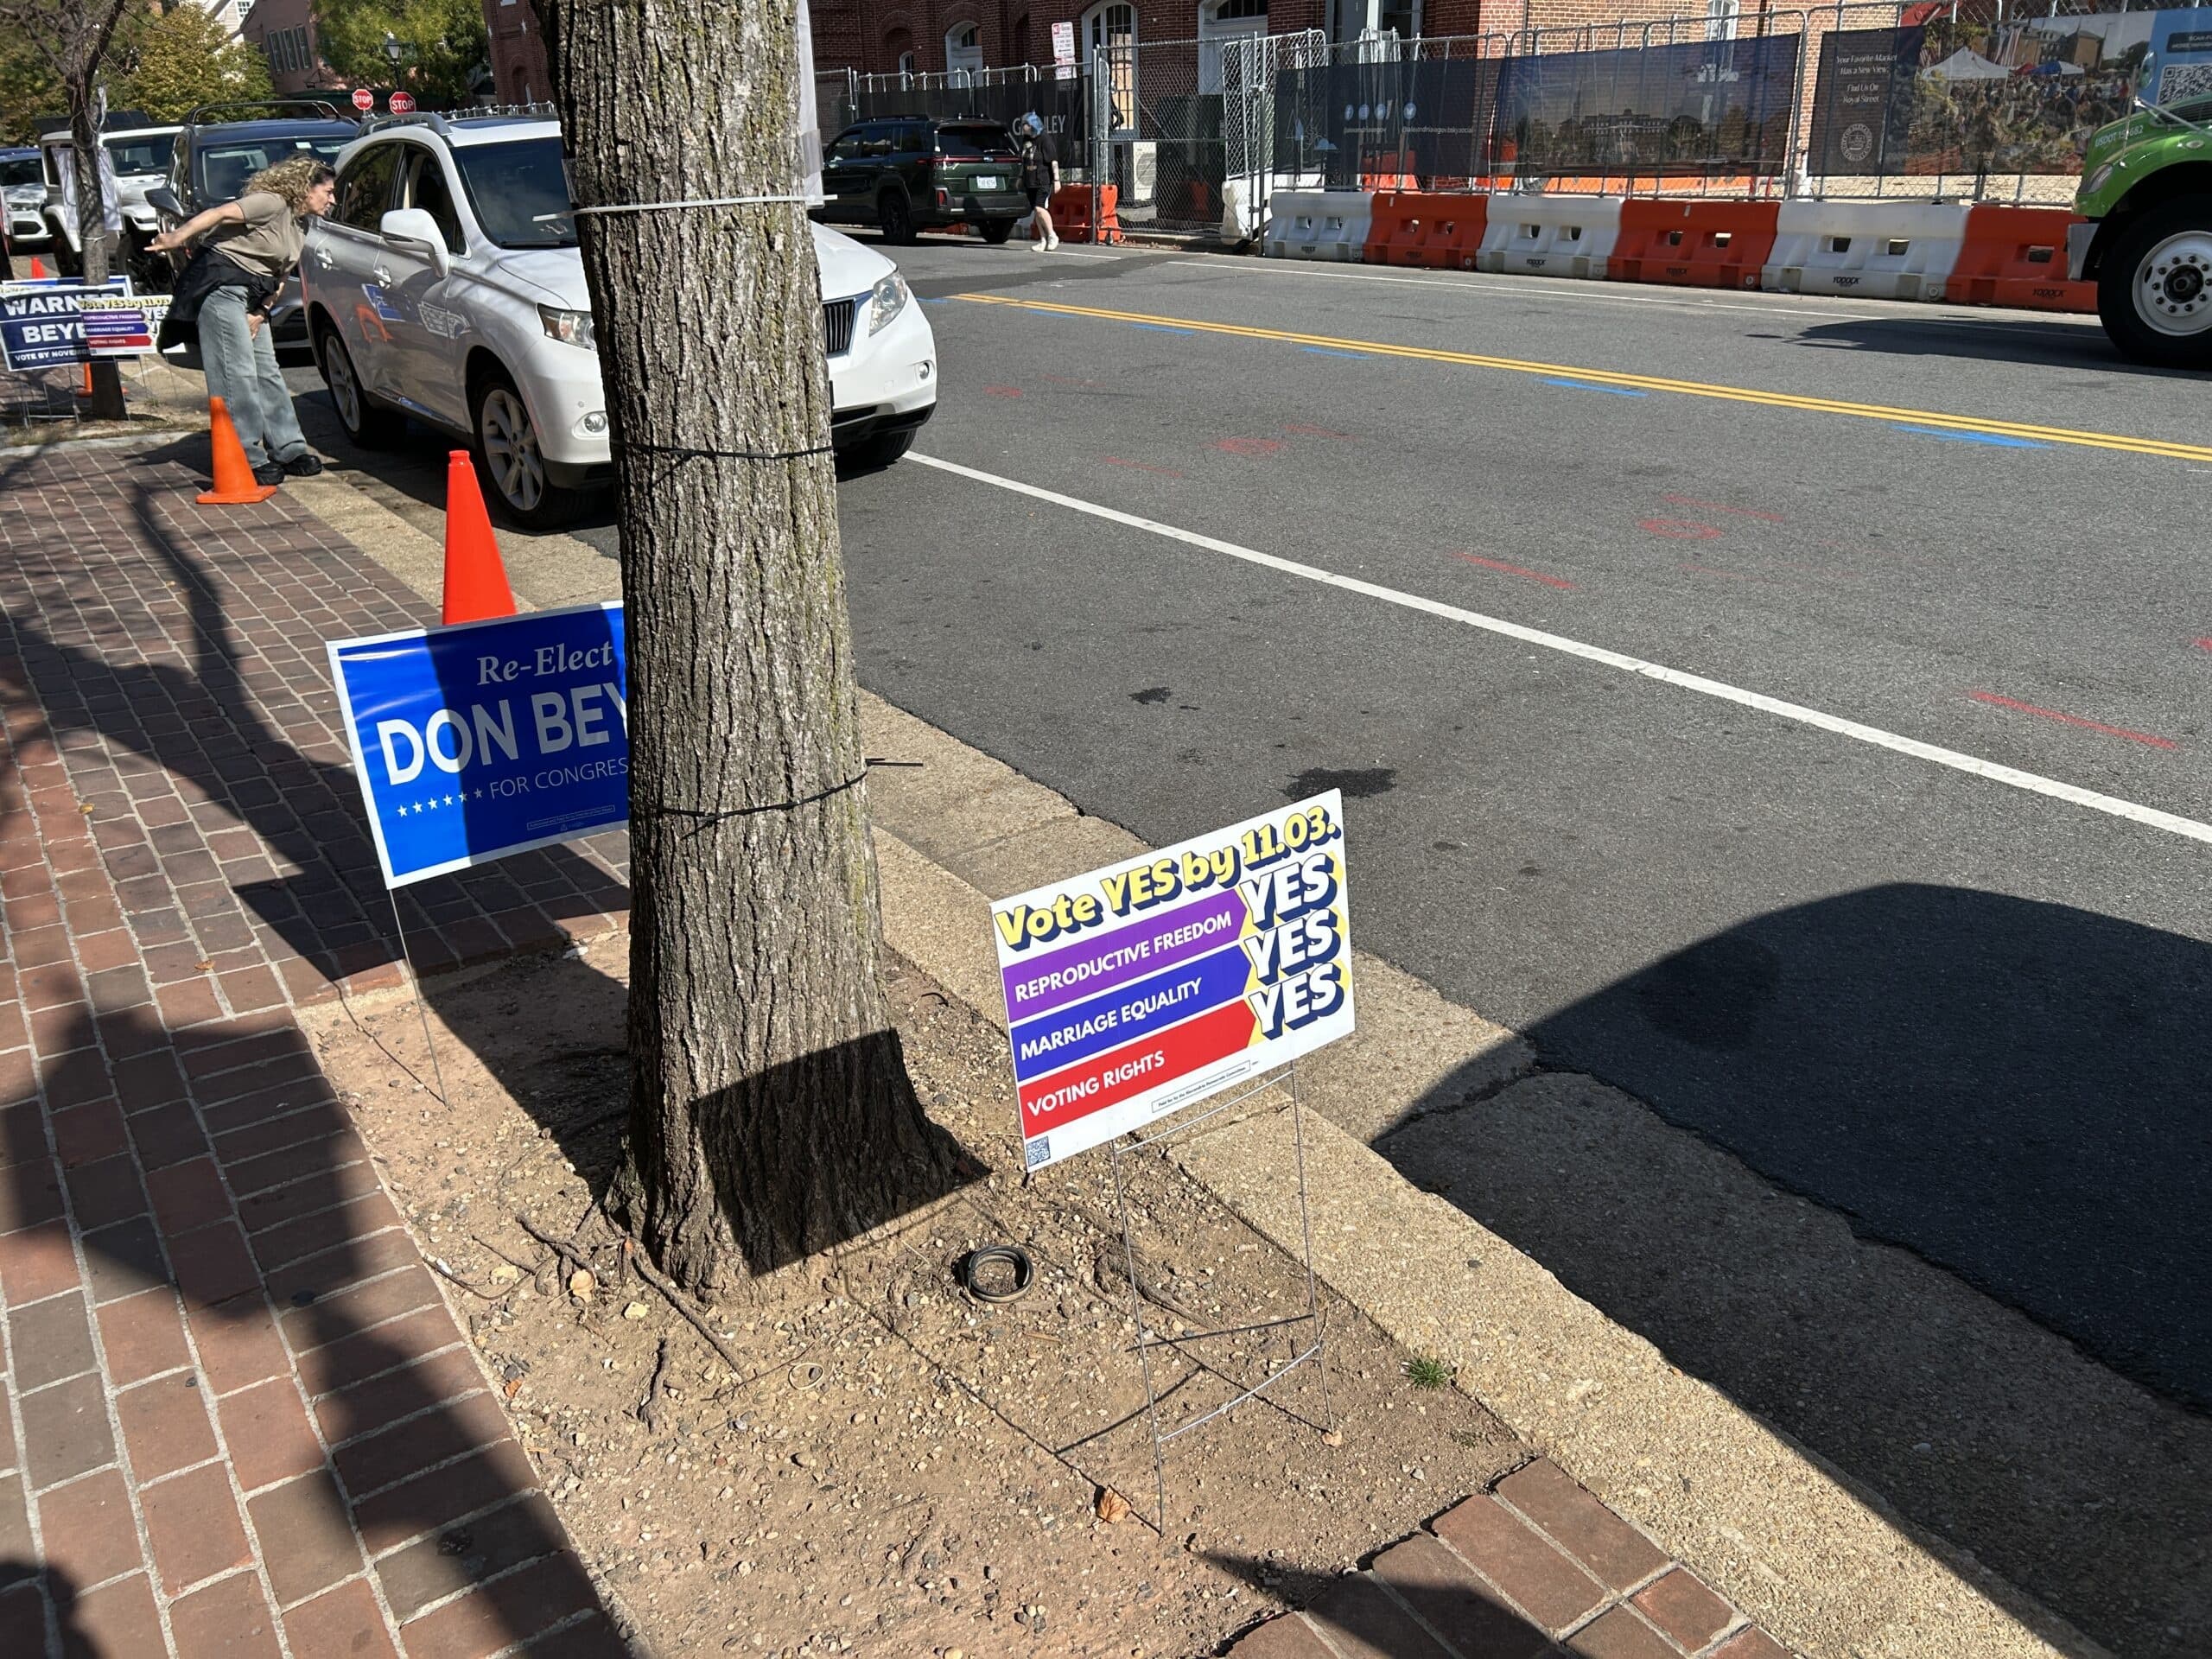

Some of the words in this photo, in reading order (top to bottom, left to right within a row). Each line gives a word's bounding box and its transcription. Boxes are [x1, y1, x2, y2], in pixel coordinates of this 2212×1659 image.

[353, 95, 372, 104] STOP
[392, 99, 414, 110] STOP
[1843, 94, 1859, 104] Royal
[1861, 94, 1880, 103] Street
[2094, 133, 2117, 147] USDOT
[2119, 125, 2144, 139] 15682
[78, 300, 104, 309] Vote
[105, 299, 125, 308] YES
[125, 298, 142, 309] by
[15, 353, 36, 361] VOTE
[38, 351, 49, 359] BY
[476, 640, 613, 685] Re-Elect
[377, 699, 519, 786] DON
[490, 776, 531, 799] FOR
[995, 893, 1103, 952] Vote
[1101, 858, 1183, 917] YES
[1181, 846, 1240, 890] by
[1241, 805, 1341, 872] 11.03.
[1015, 939, 1150, 1002] REPRODUCTIVE
[1154, 911, 1232, 951] FREEDOM
[1239, 854, 1340, 931] YES
[1020, 1014, 1117, 1060] MARRIAGE
[1122, 978, 1202, 1022] EQUALITY
[1243, 909, 1344, 985] YES
[1027, 1077, 1099, 1116] VOTING
[1103, 1051, 1165, 1087] RIGHTS
[1249, 963, 1345, 1039] YES
